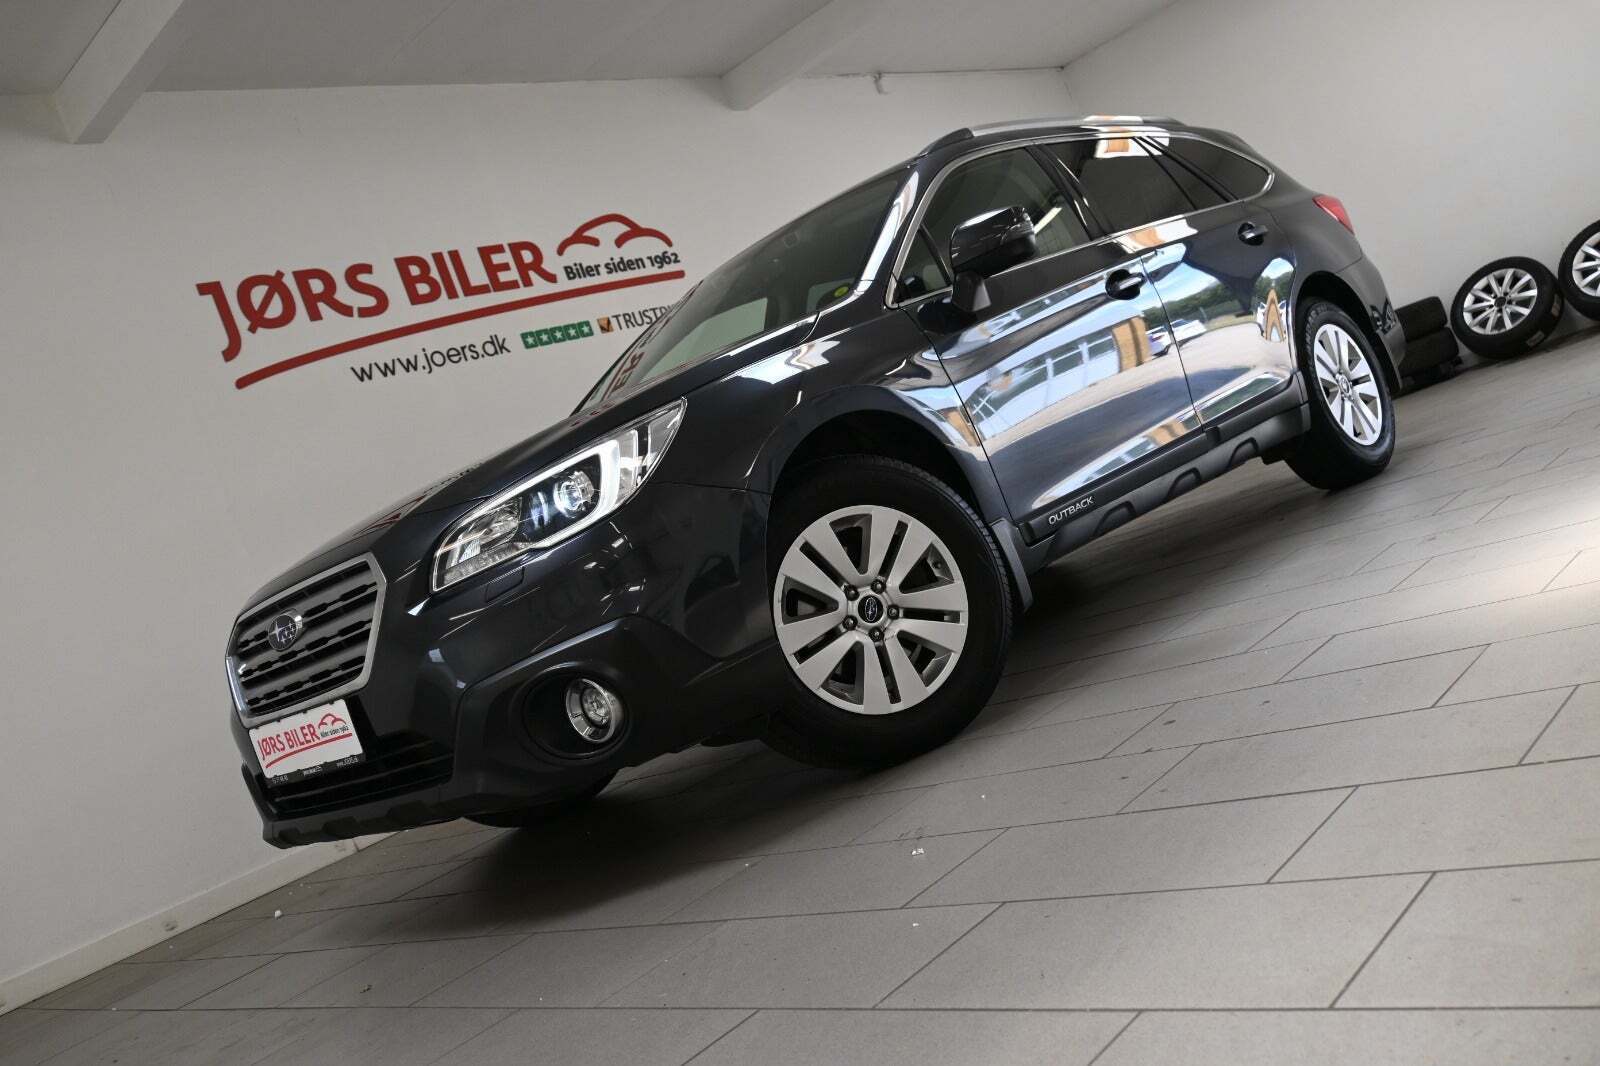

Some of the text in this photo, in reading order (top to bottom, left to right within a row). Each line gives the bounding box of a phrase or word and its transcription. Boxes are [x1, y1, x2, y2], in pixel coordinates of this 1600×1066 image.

[563, 250, 681, 281] Biler siden 1962
[195, 241, 558, 363] JØRS BILER
[350, 334, 511, 383] www.joers.dk
[1048, 495, 1094, 525] OUTBACK
[257, 723, 321, 760] JØRS BILER
